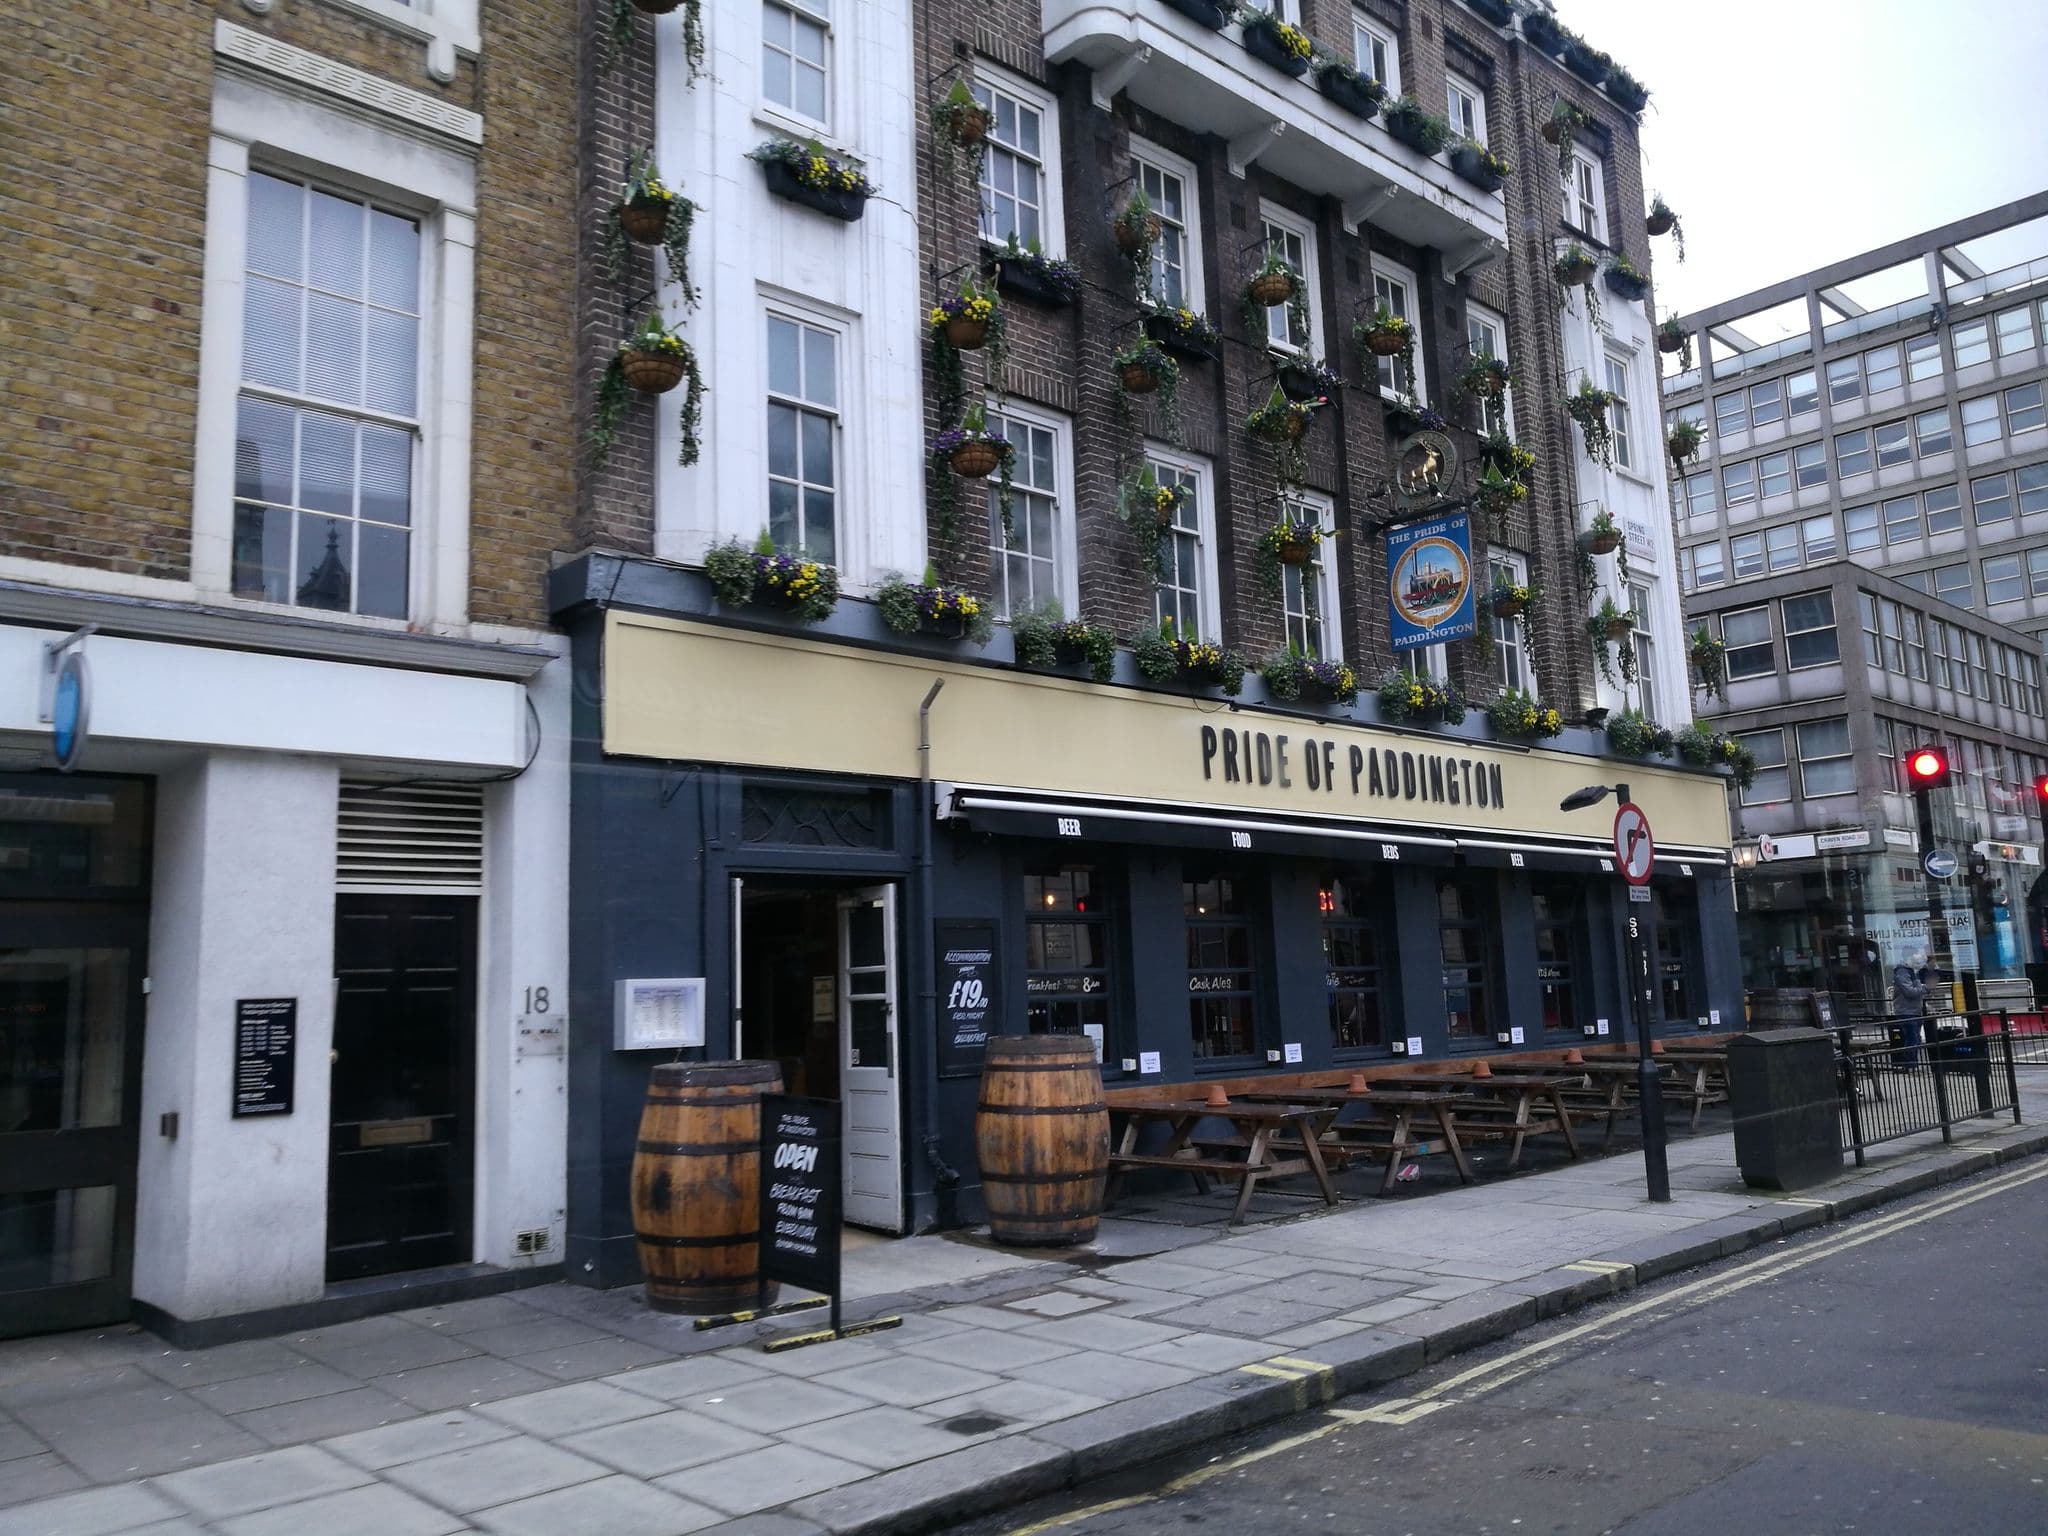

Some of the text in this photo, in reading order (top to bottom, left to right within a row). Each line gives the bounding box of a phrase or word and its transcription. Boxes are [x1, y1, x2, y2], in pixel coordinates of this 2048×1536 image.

[1389, 518, 1467, 546] THE PRIDE OF
[1394, 622, 1473, 647] PADDINGTON
[1201, 725, 1505, 810] PRIDE OF PADDINGTON
[1057, 817, 1082, 837] BEER
[1231, 831, 1252, 849] FOOD
[1381, 844, 1400, 860] BEDS
[1510, 852, 1525, 867] BEER
[944, 952, 992, 962] ACCOMMODATION
[1189, 976, 1232, 991] Cask Ales
[524, 985, 550, 1015] 18
[947, 979, 989, 1009] £19.00
[954, 1033, 988, 1044] BREAKFAST
[773, 1142, 819, 1173] OPEN
[769, 1183, 823, 1204] BREAKFAST
